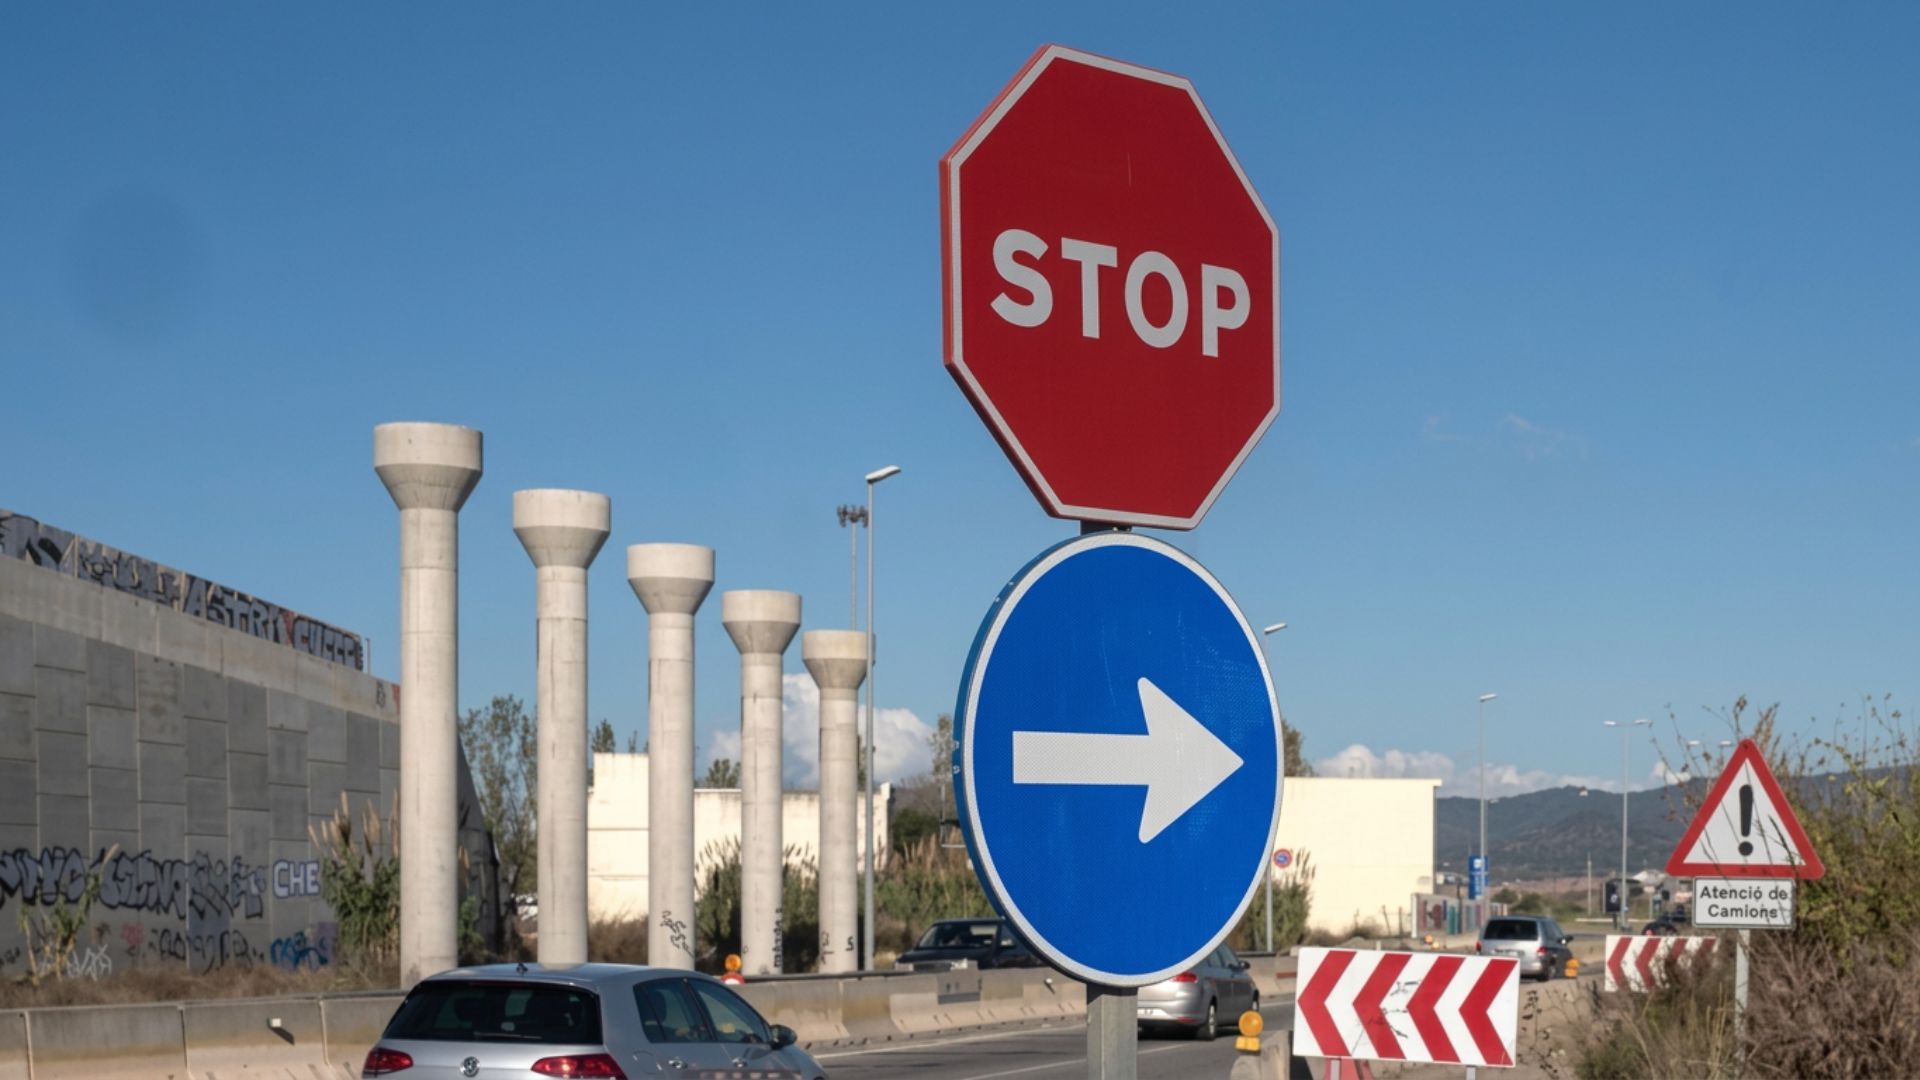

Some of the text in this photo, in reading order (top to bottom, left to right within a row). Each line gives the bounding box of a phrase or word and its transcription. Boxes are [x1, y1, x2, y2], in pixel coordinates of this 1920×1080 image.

[990, 228, 1251, 358] STOP
[273, 858, 320, 897] CHE
[1700, 885, 1788, 900] Atenció de
[1707, 903, 1778, 918] Camions
